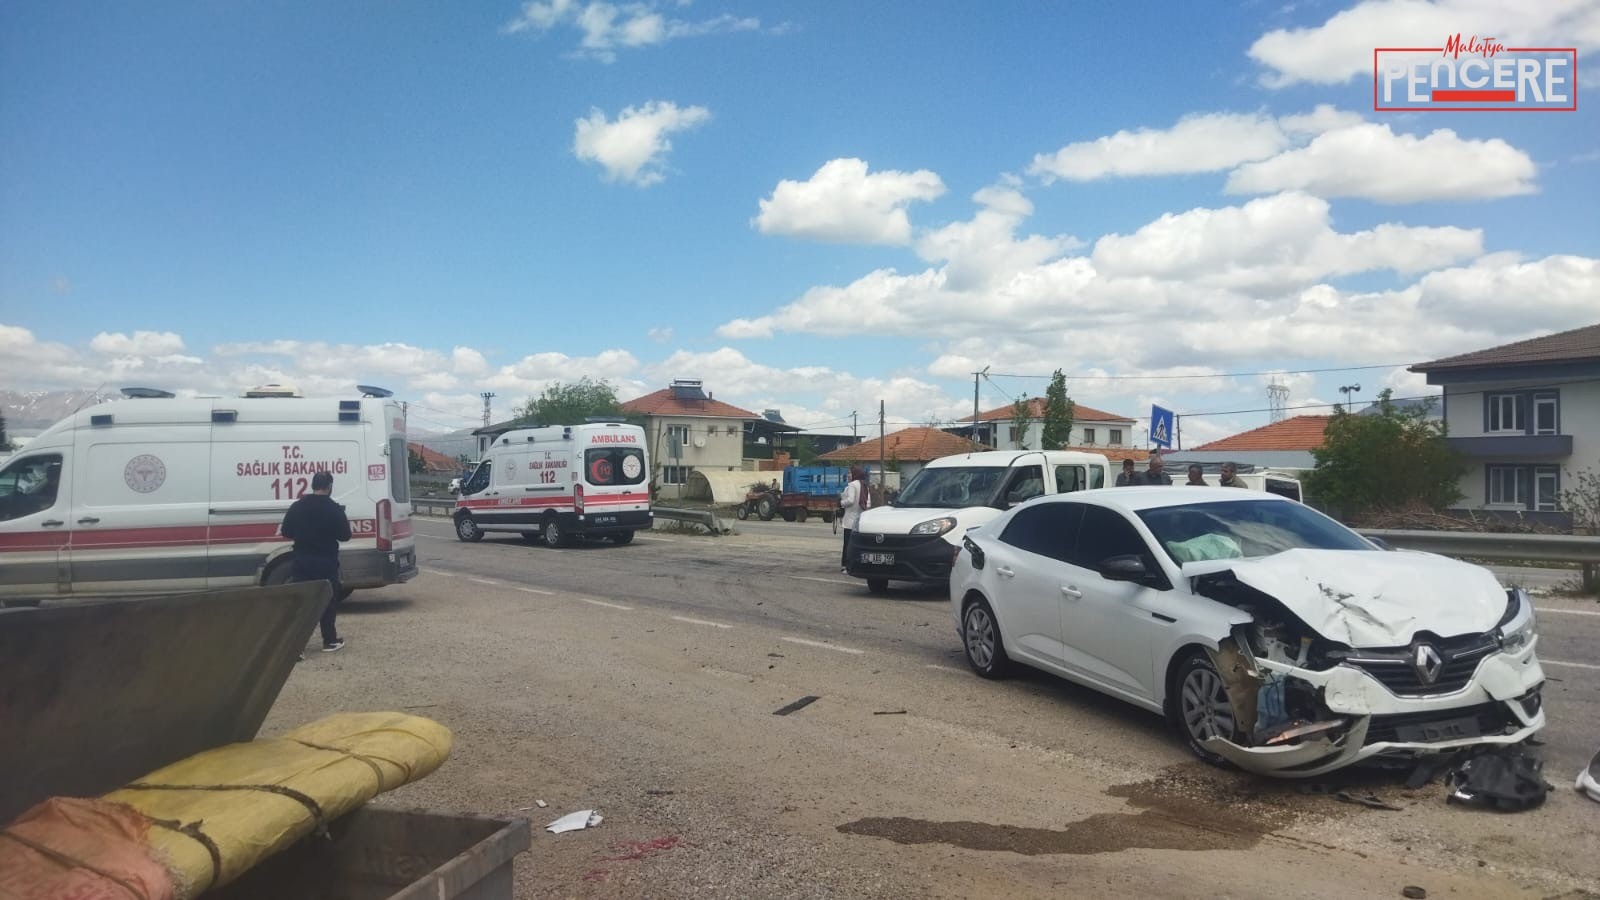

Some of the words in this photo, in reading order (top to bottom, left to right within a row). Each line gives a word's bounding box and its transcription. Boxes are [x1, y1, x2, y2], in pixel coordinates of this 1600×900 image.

[591, 434, 636, 444] AMBULANS
[282, 446, 304, 459] T.C.
[237, 460, 280, 476] SAĞLIK
[284, 458, 347, 475] BAKANLIĞI
[539, 470, 556, 484] 112
[271, 477, 309, 500] 112
